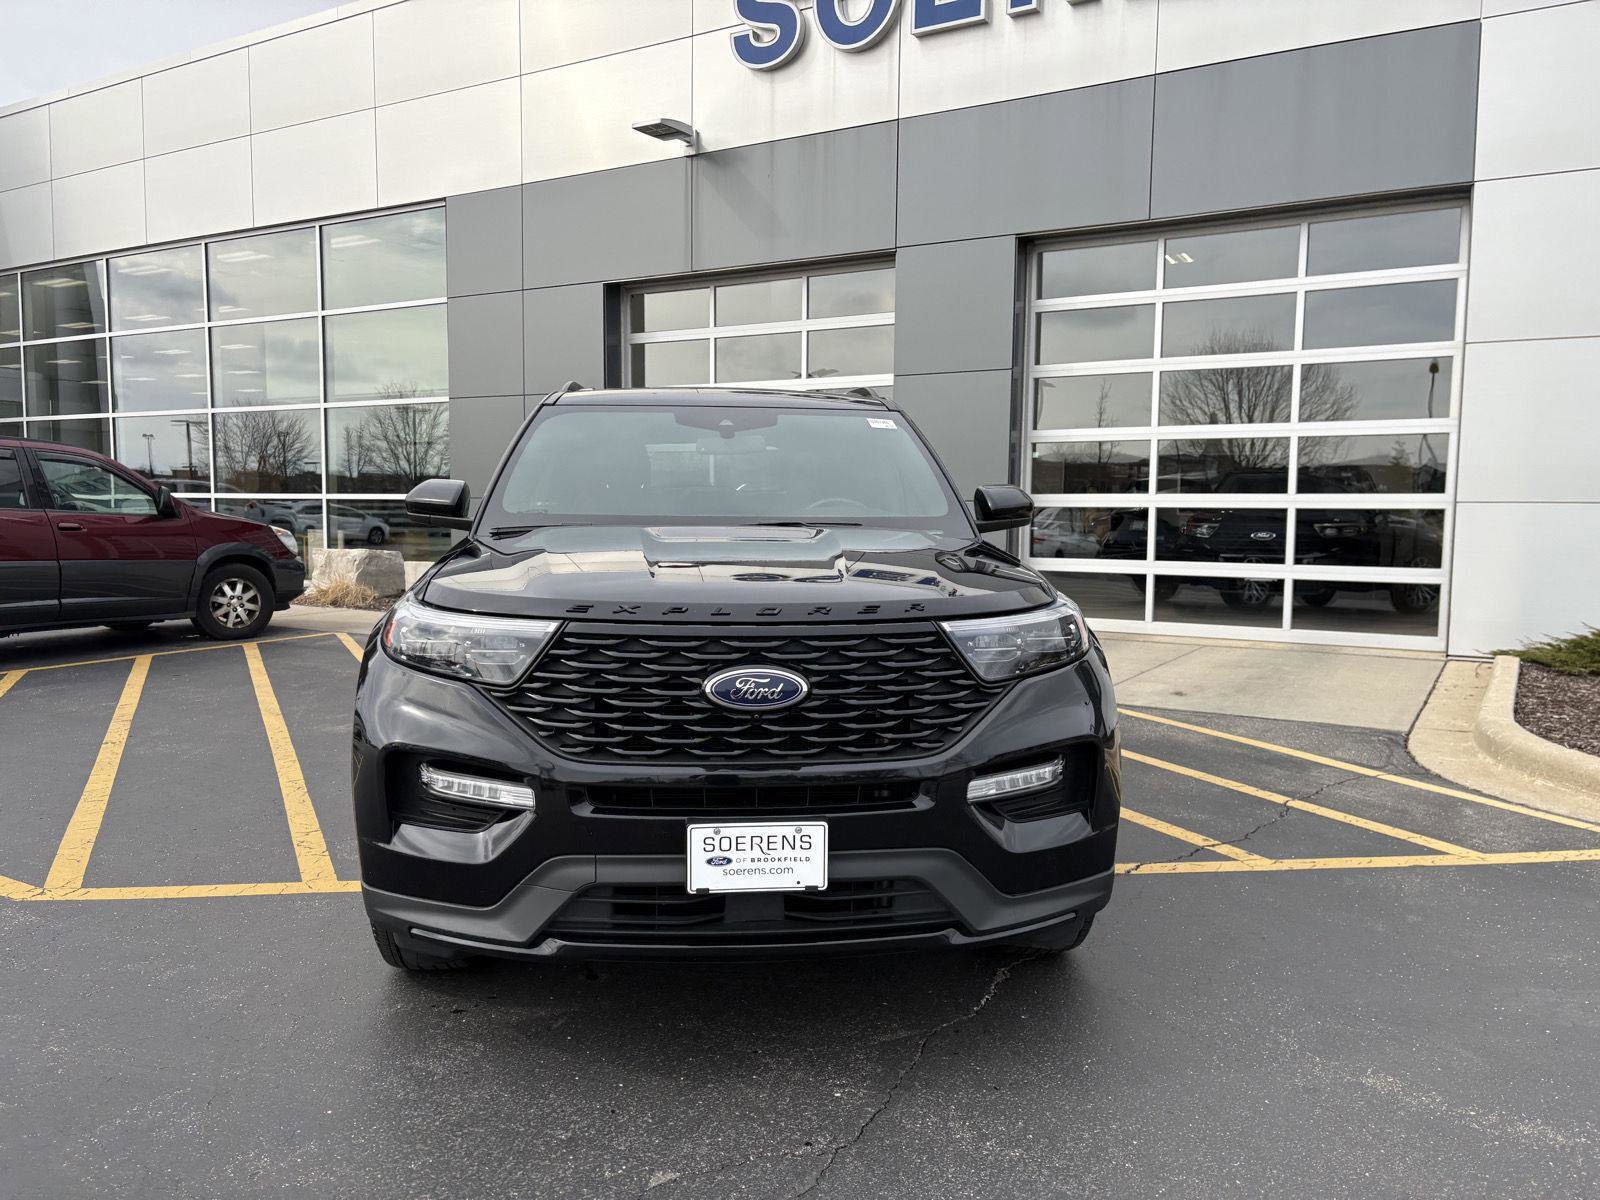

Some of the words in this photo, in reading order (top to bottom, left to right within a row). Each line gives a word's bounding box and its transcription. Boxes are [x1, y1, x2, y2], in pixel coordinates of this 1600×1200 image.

[565, 603, 925, 616] EXPLORER
[729, 677, 784, 700] Ford
[703, 834, 812, 855] SOERENS
[722, 866, 794, 876] soerens.com
